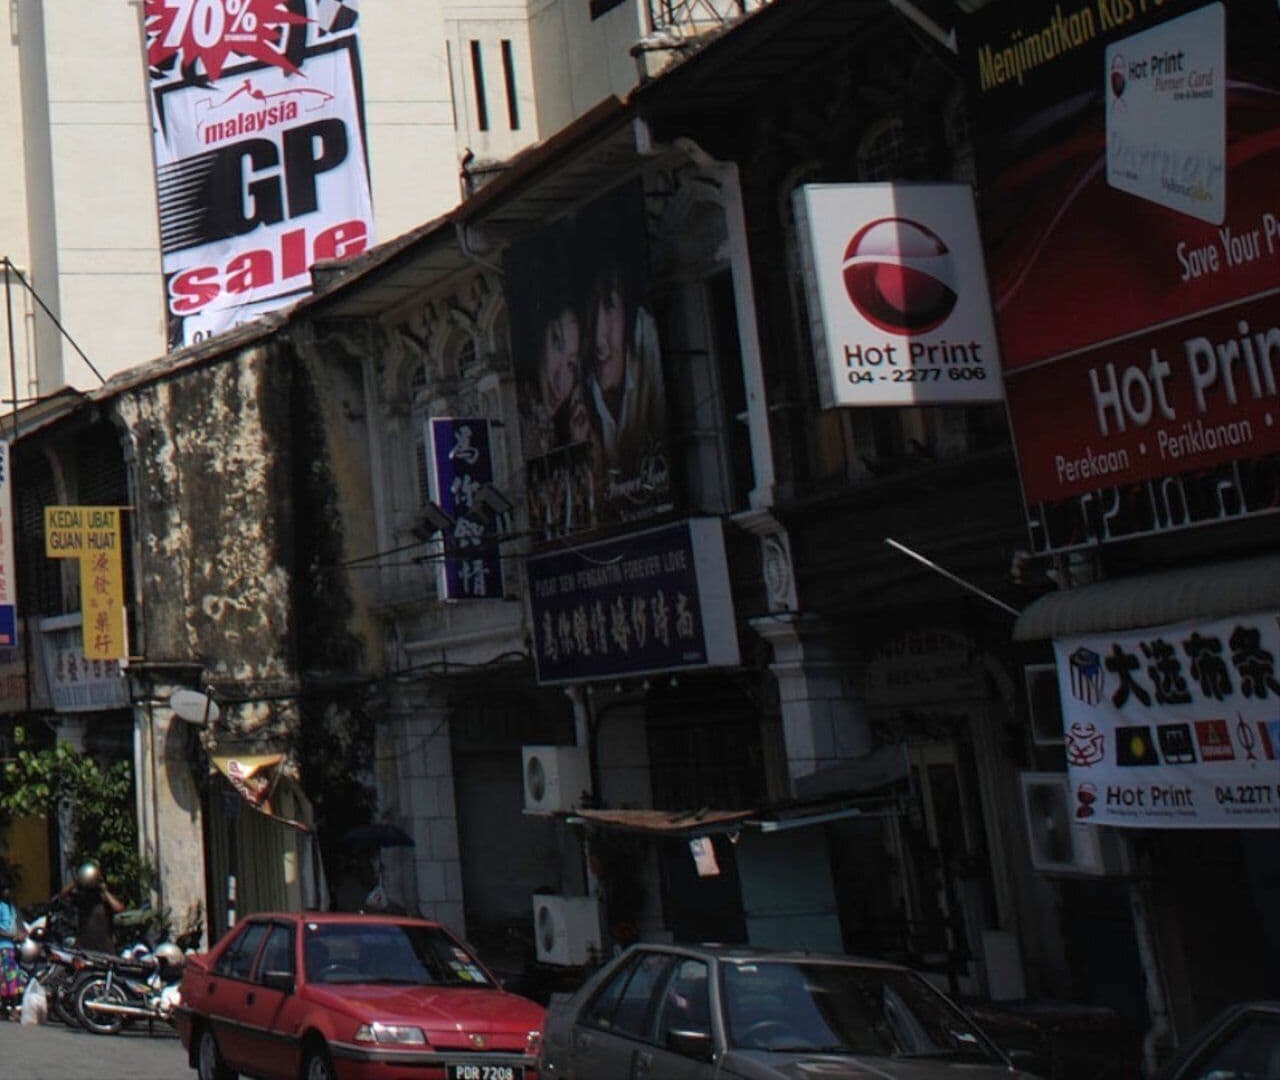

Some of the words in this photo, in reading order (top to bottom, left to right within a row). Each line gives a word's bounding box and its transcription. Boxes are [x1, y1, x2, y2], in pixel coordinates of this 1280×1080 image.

[977, 2, 1097, 93] Menjimatkan
[1150, 51, 1185, 77] Print
[204, 101, 298, 145] malaysia
[175, 117, 349, 250] GP
[1176, 240, 1221, 282] Save
[1219, 224, 1261, 271] Your
[1262, 212, 1280, 256] P
[171, 219, 368, 312] sale
[844, 343, 897, 367] Hot
[907, 339, 982, 366] Print
[848, 369, 874, 385] 04
[892, 367, 940, 383] 2277
[948, 366, 987, 381] 606
[1089, 346, 1178, 438] Hot
[1055, 446, 1130, 484] Perekaan
[1156, 418, 1254, 461] Periklanan
[48, 509, 83, 529] KEDAI
[87, 510, 116, 529] UBAT
[49, 531, 83, 550] GUAN
[87, 532, 116, 550] HUAT
[1107, 785, 1144, 806] Hot
[1150, 784, 1193, 806] Print
[456, 1065, 480, 1080] PDR
[481, 1066, 514, 1080] 7208
